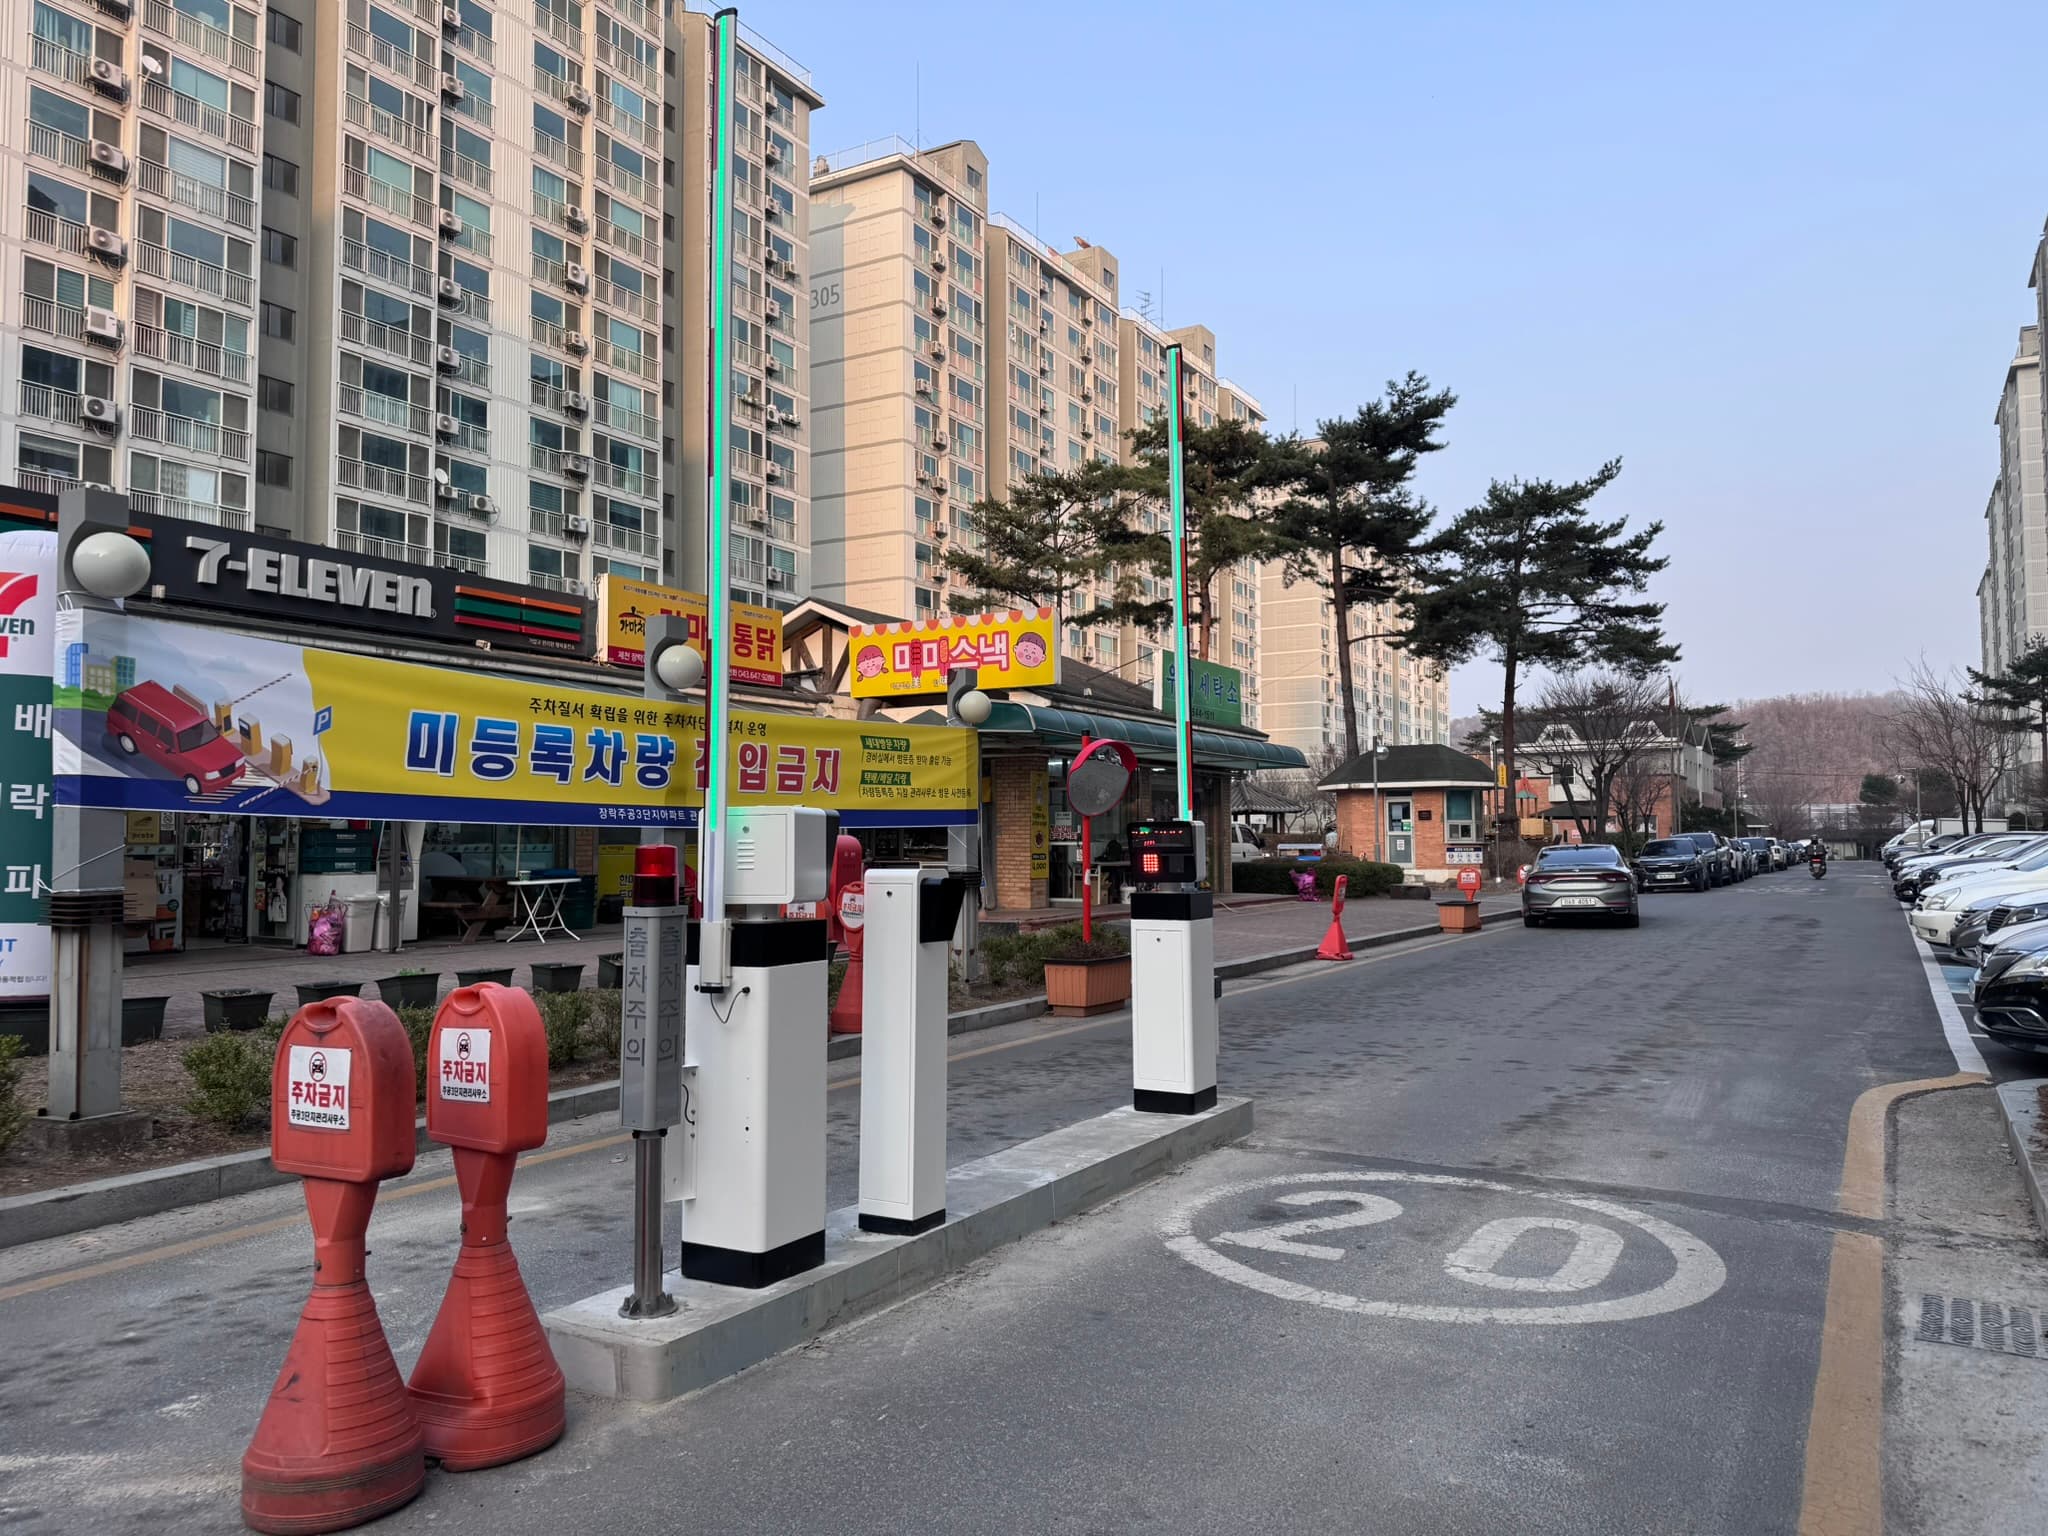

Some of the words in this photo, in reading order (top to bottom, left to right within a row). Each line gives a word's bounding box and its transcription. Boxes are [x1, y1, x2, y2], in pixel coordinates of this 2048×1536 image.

[811, 284, 840, 309] 305
[529, 697, 584, 718] 주차질서
[590, 703, 629, 723] 확립을
[634, 709, 658, 726] 위한
[748, 721, 767, 737] 운영
[405, 709, 676, 788] 미등록차량
[598, 807, 686, 821] 장락주공3단지아파트
[626, 927, 648, 1067] 출차주의
[442, 1060, 487, 1084] 주차금지
[291, 1080, 345, 1109] 주차금지
[1209, 1189, 1624, 1292] 20
